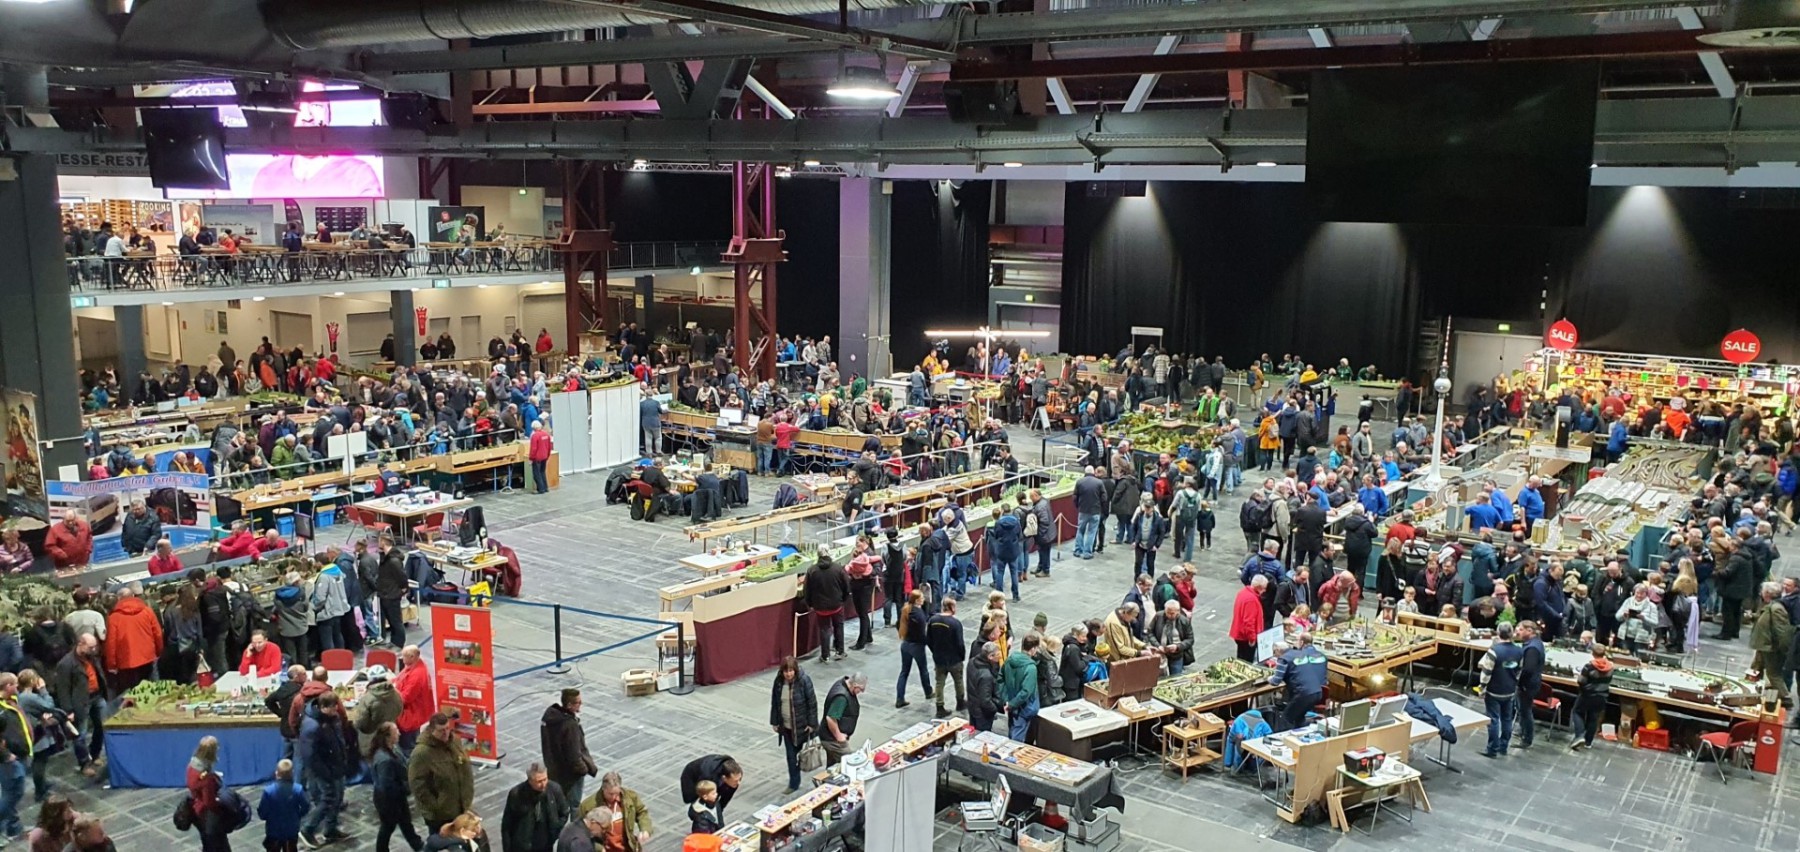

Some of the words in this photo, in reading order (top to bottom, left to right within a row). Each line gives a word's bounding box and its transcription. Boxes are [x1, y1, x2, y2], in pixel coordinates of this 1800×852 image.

[57, 153, 150, 166] ESSE-RESTA
[1551, 328, 1575, 343] SALE
[1724, 340, 1757, 353] SALE
